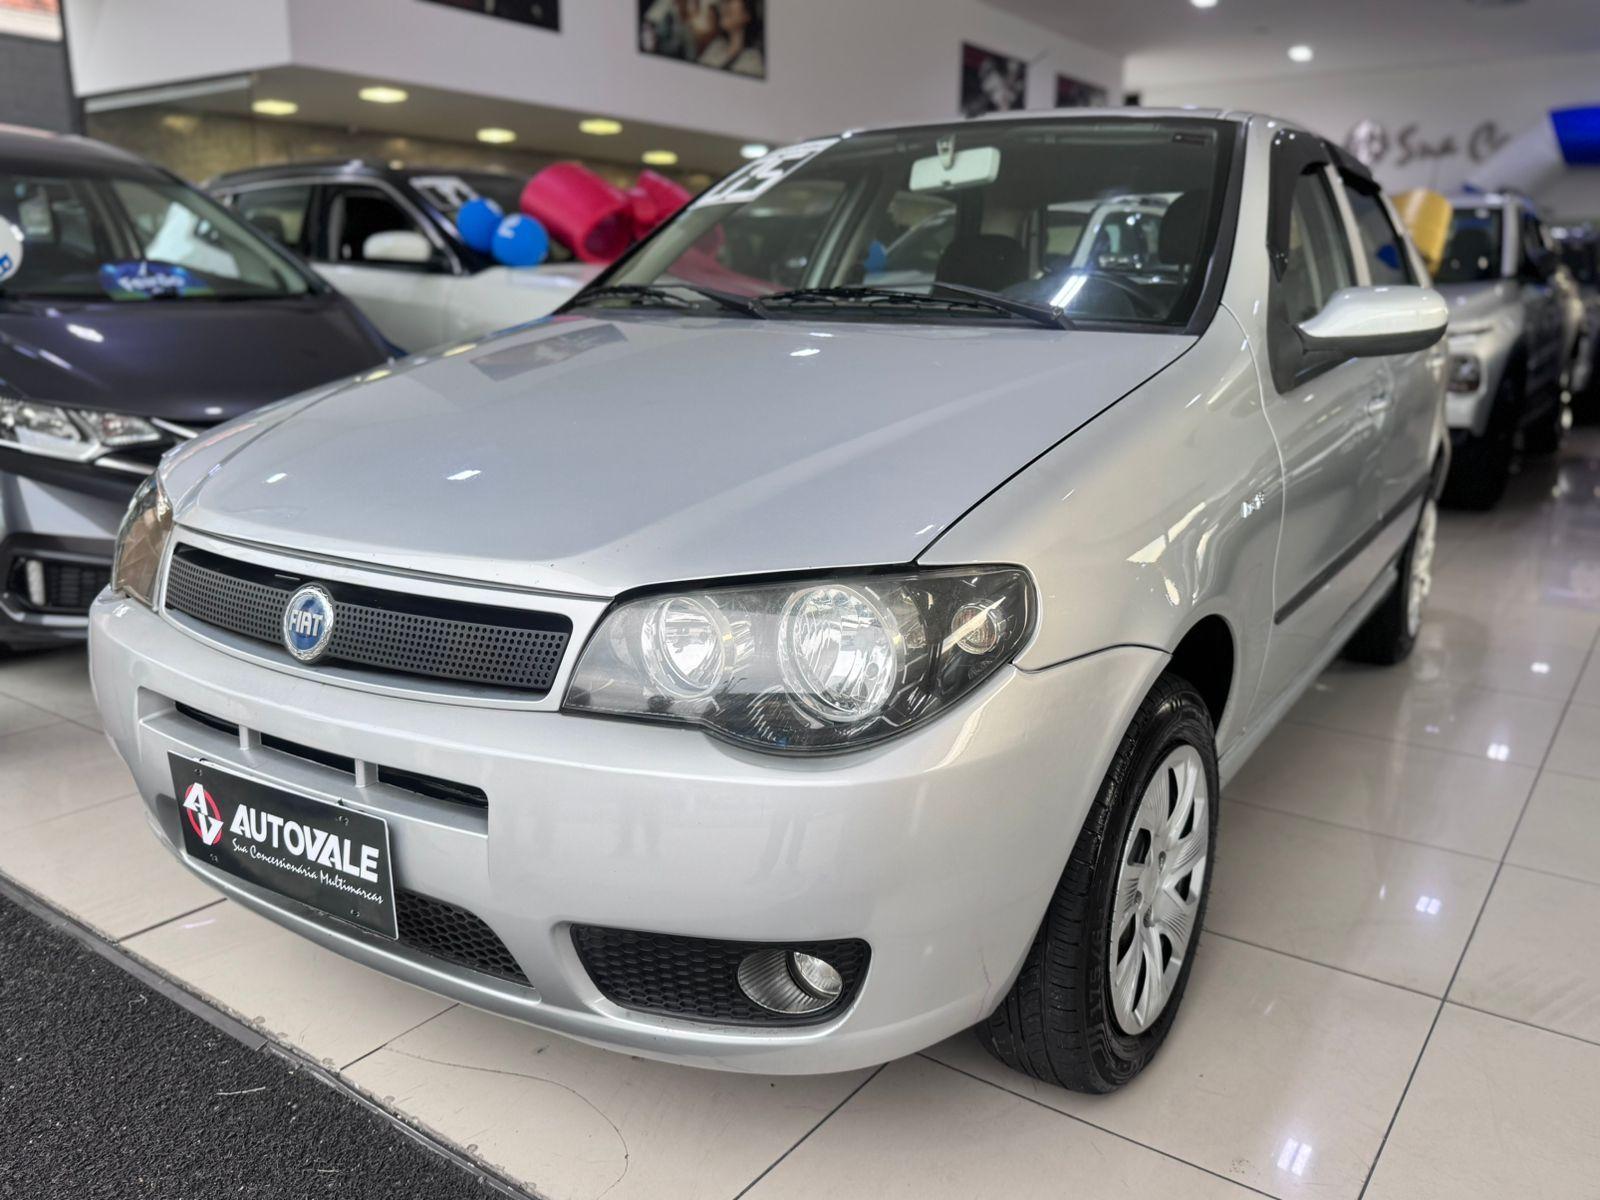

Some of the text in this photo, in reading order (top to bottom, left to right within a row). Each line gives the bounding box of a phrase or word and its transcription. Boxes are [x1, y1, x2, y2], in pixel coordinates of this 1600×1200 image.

[289, 609, 324, 636] FIAT
[229, 803, 379, 883] AUTOVALE
[232, 837, 384, 904] Sua Concessionária Multimarcas
